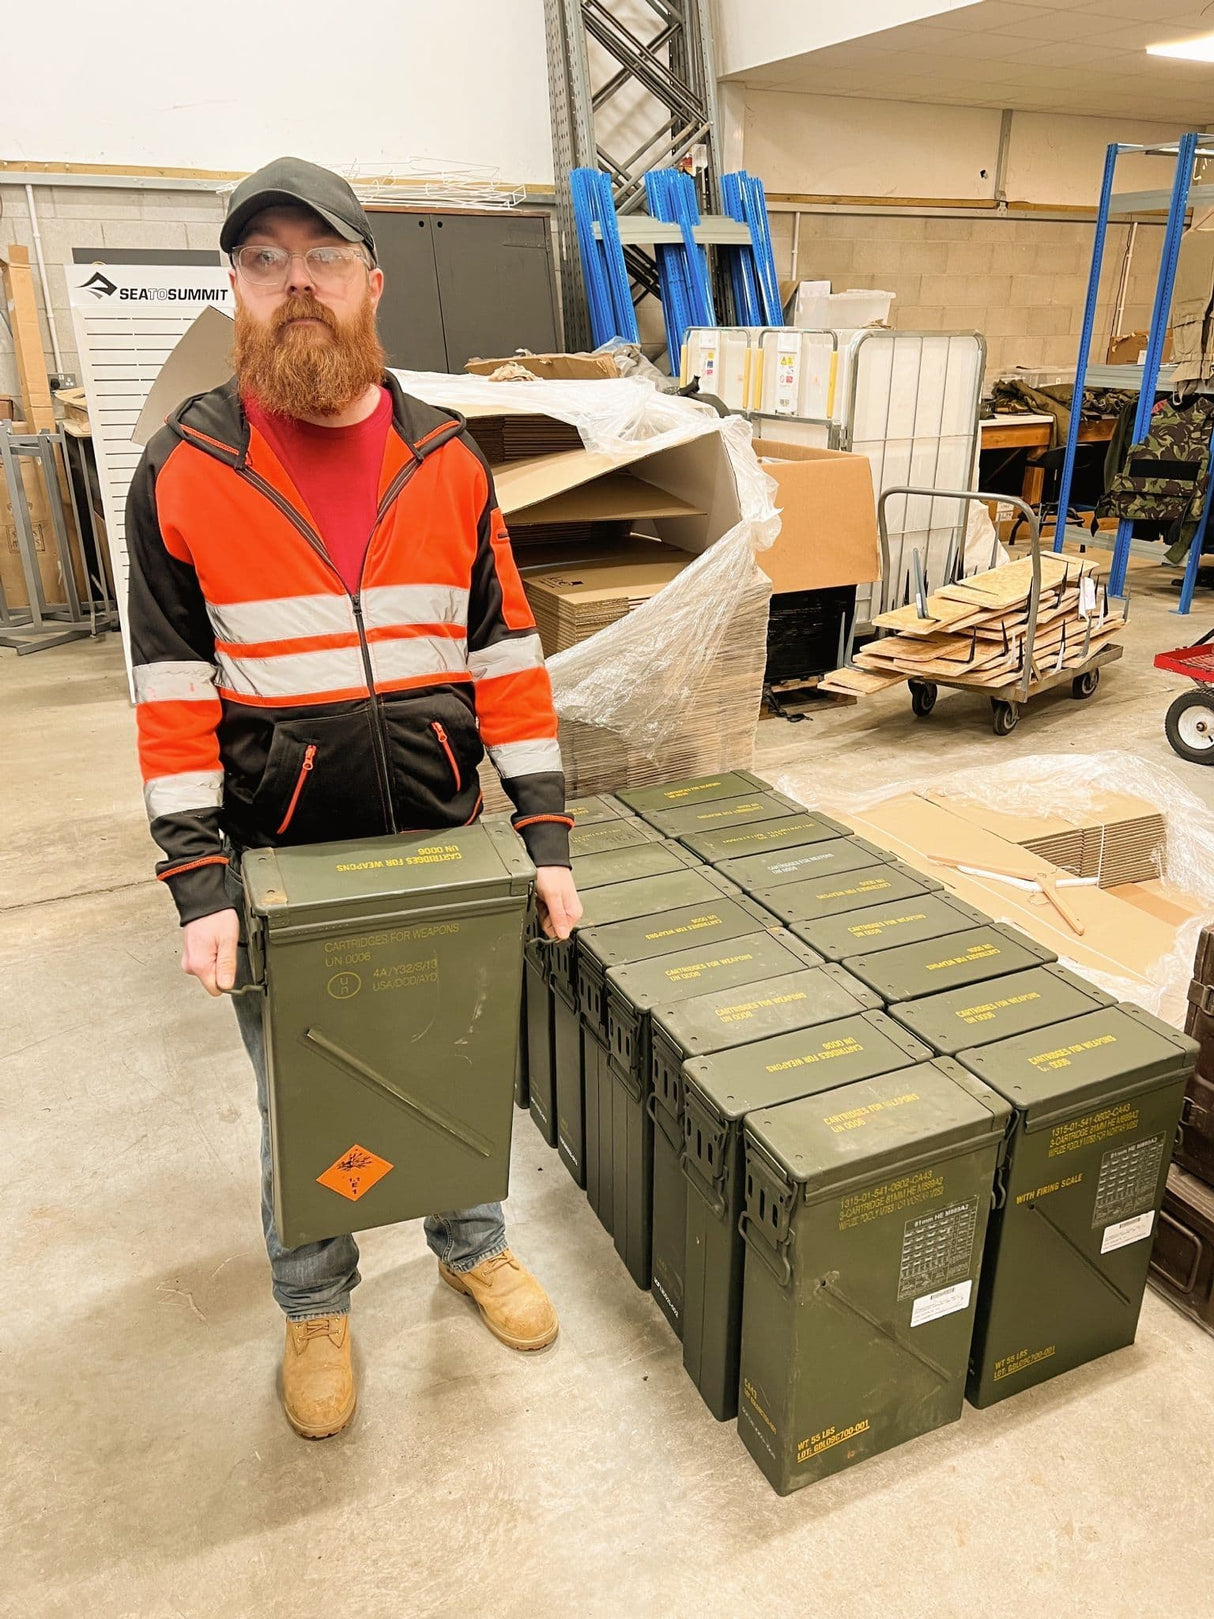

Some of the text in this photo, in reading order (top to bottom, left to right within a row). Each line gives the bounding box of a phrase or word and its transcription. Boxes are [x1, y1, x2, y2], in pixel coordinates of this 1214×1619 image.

[418, 845, 459, 856] UN 0006
[336, 853, 462, 872] CARTRIDGES FOR WEAPONS
[325, 924, 460, 953] CARTRIDGES FOR WEAPONS
[325, 952, 371, 967] UN 0006
[1017, 1173, 1083, 1205] WITH FIRING SCALE
[798, 1426, 836, 1451] WT 55 LBS
[797, 1448, 812, 1461] LOT:
